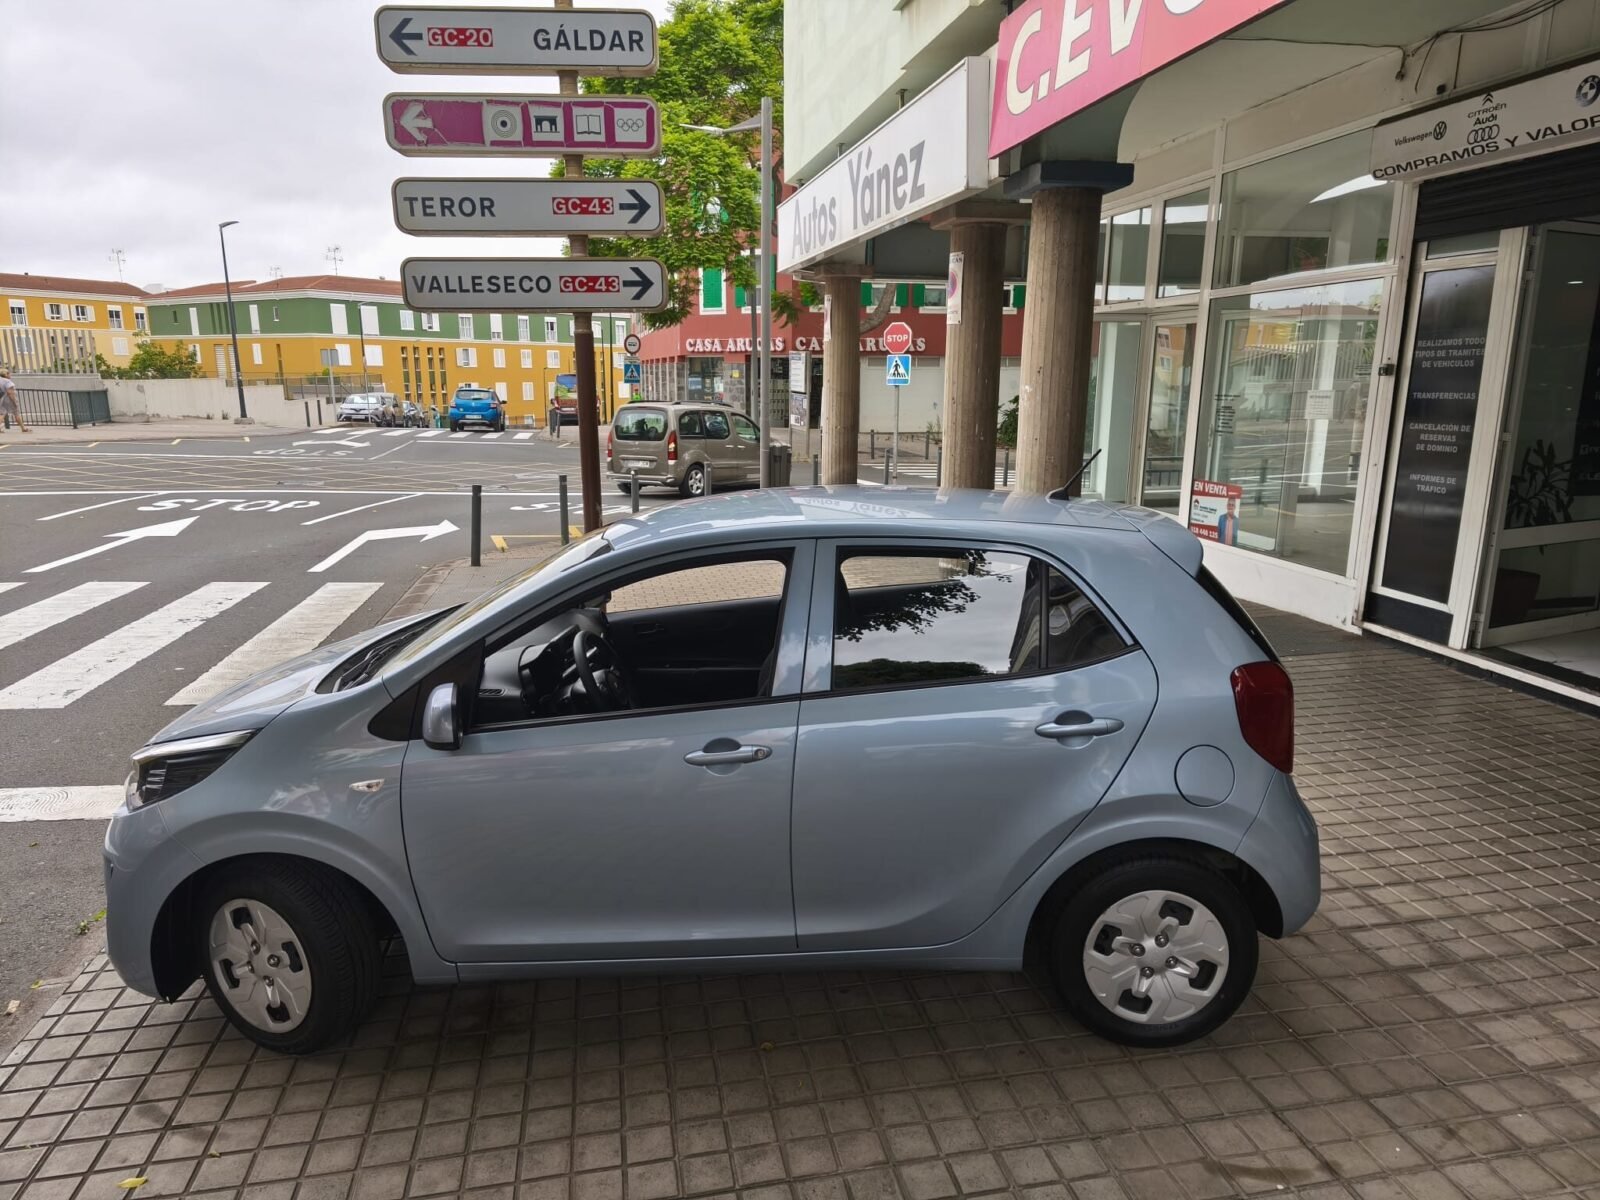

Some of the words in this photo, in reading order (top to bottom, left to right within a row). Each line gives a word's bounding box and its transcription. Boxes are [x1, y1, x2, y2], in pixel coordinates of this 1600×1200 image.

[428, 28, 492, 47] GC-20
[533, 24, 645, 52] GÁLDAR
[1006, 0, 1202, 116] C.EV
[1473, 113, 1498, 127] Audi
[1394, 131, 1433, 147] Volkswagen
[1373, 141, 1500, 179] COMPRAMOS
[1504, 136, 1519, 148] Y
[792, 196, 837, 259] Autos
[848, 140, 926, 230] Yánez
[403, 197, 496, 218] TEROR
[553, 198, 614, 215] GC-43
[411, 275, 552, 294] VALLESECO
[560, 276, 620, 293] GC-43
[685, 338, 721, 352] CASA
[796, 337, 824, 351] CA
[887, 334, 909, 343] STOP
[1417, 338, 1463, 348] REALIZAMOS
[1415, 350, 1435, 358] TIPOS
[1436, 349, 1447, 357] DE
[1413, 392, 1476, 400] TRANSFERENCIAS
[1460, 425, 1471, 433] DE
[1420, 433, 1457, 442] RESERVAS
[253, 448, 354, 457] STOP
[1426, 444, 1458, 453] DOMINIO
[1409, 474, 1445, 484] INFORMES
[1446, 477, 1457, 485] DE
[1194, 481, 1203, 491] EN
[1205, 483, 1227, 496] VENTA
[137, 499, 321, 512] STOP
